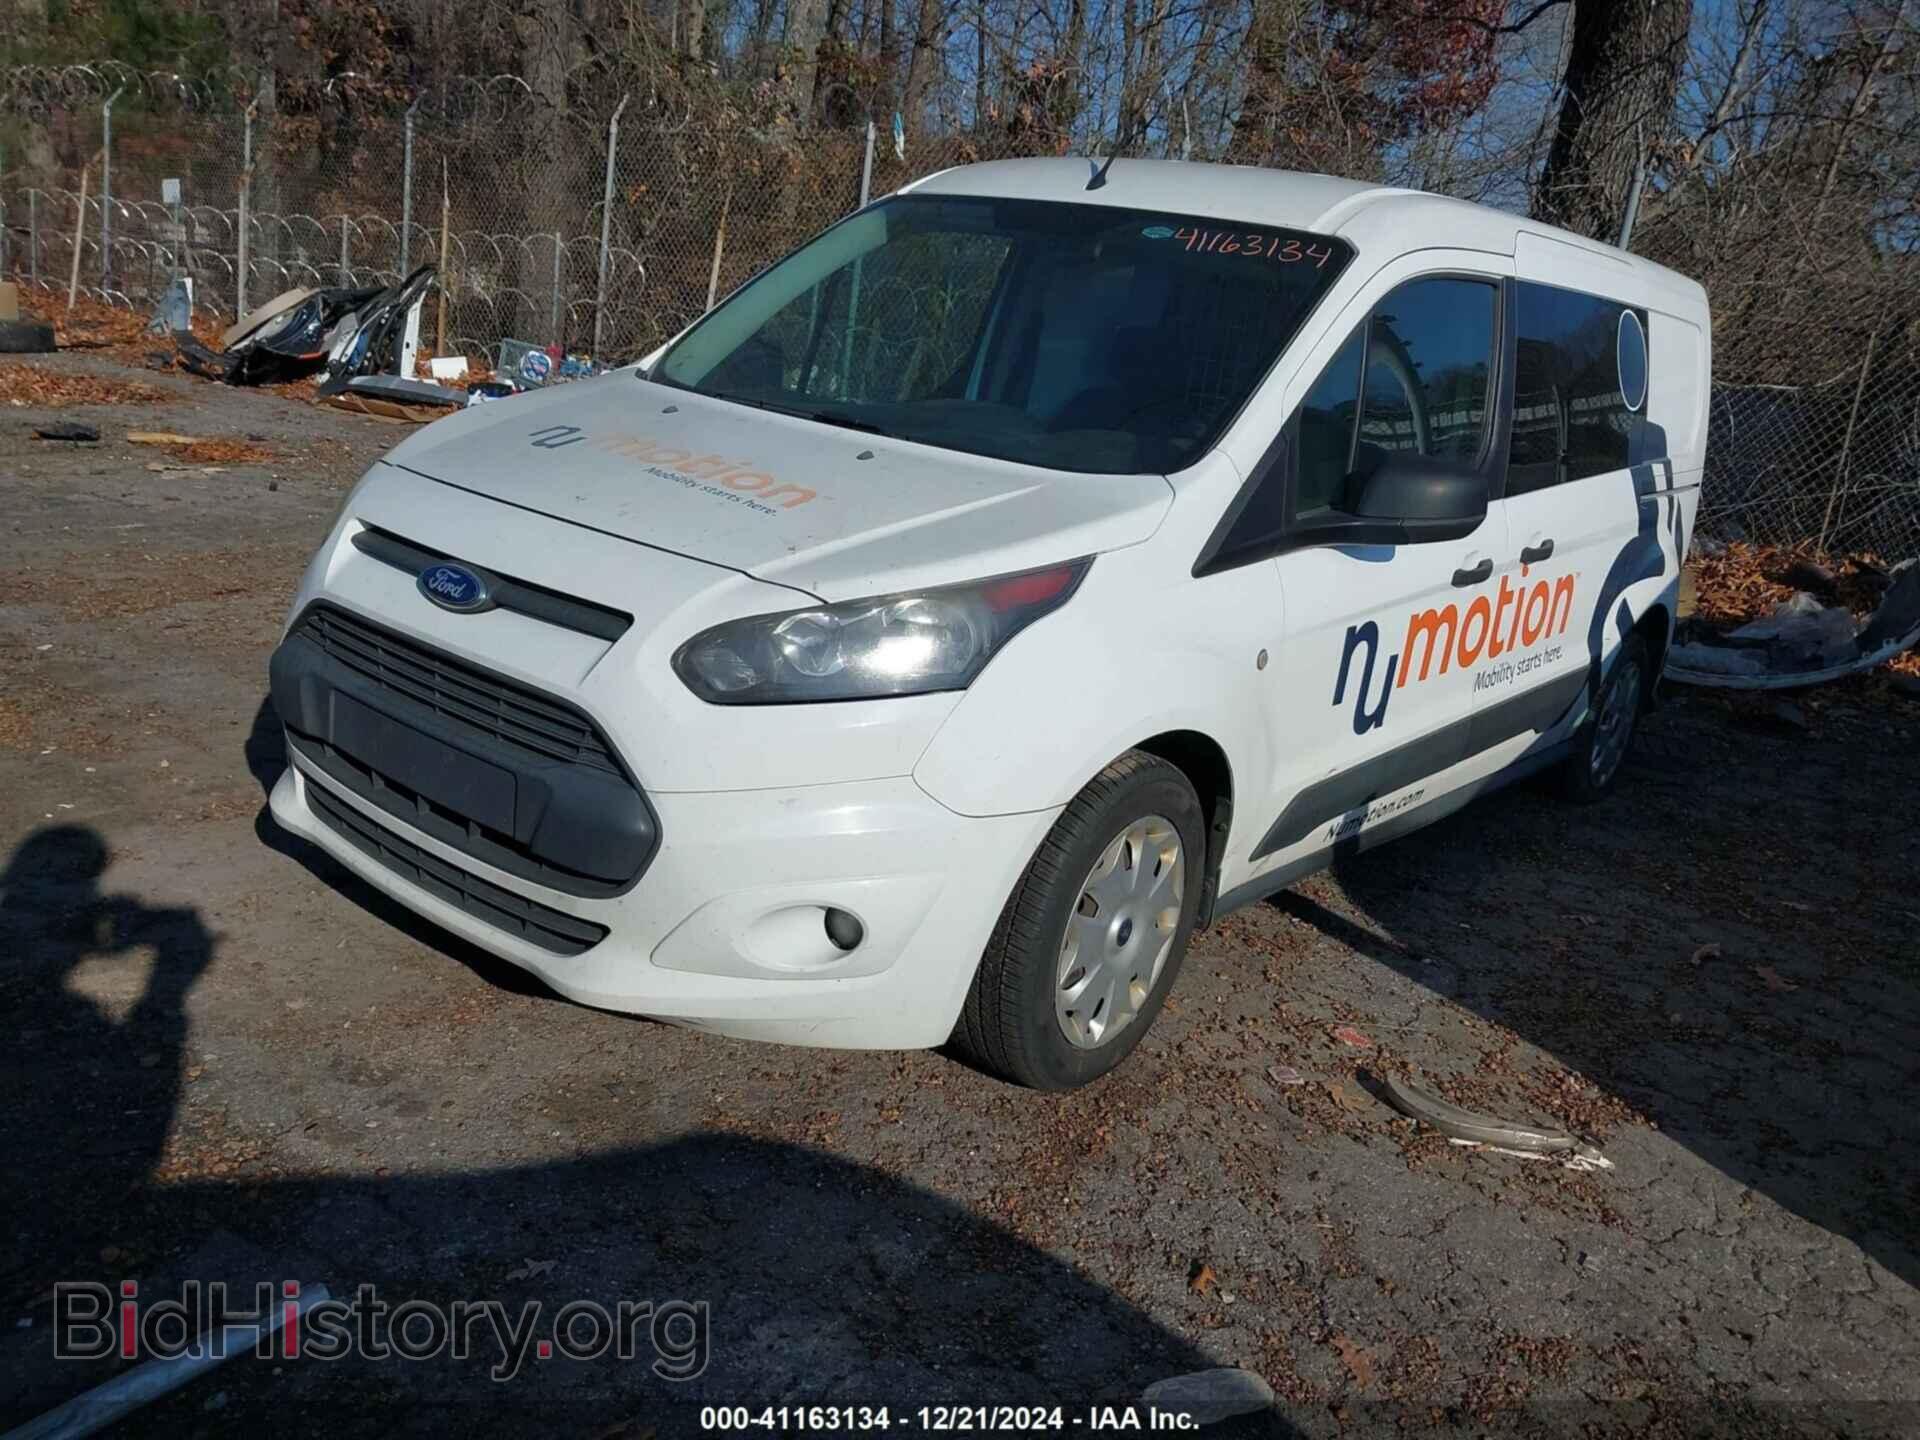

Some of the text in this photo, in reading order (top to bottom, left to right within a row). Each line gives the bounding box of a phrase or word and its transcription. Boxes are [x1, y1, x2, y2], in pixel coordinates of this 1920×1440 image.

[1174, 227, 1332, 268] 41163134
[642, 466, 777, 516] Mobility starts here.
[427, 567, 464, 599] Ford
[1473, 645, 1563, 693] Mobility starts here.
